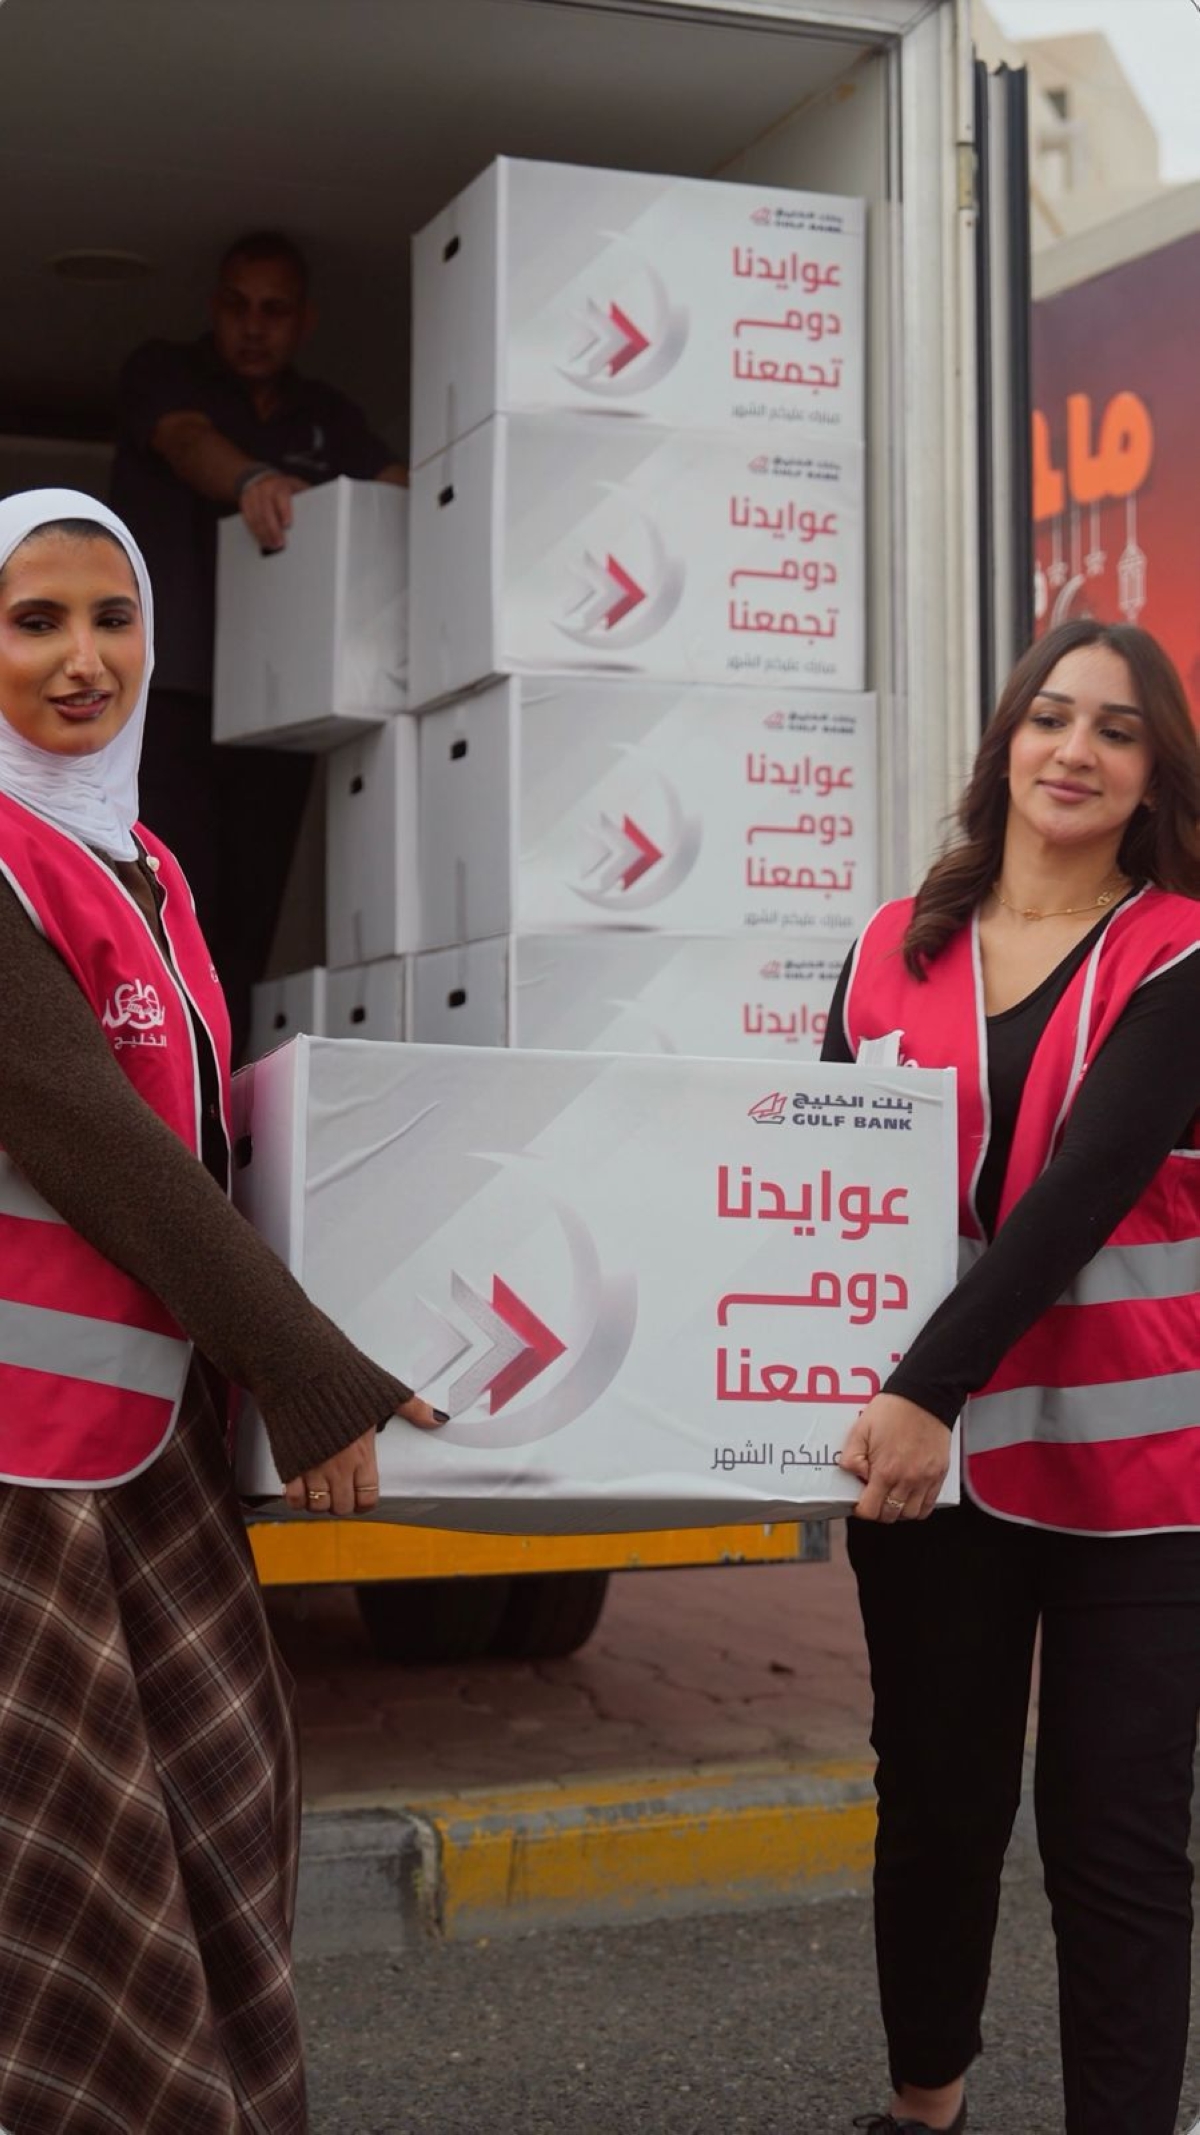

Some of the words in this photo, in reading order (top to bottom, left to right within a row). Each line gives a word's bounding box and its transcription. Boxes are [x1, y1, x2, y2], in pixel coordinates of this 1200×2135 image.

[733, 247, 841, 293] عوايدنا
[733, 349, 843, 395] تجمعنا
[730, 496, 838, 542] عوايدنا
[729, 600, 840, 645] تجمعنا
[746, 753, 853, 796] عوايدنا
[746, 857, 856, 899] تجمعنا
[114, 1033, 167, 1050] الخليج
[743, 1003, 828, 1044] وايدنا
[792, 1093, 863, 1109] الخليج
[792, 1113, 845, 1127] GULF
[854, 1116, 912, 1130] BANK
[872, 1097, 913, 1113] بنك
[718, 1165, 909, 1240] عوايدنا
[717, 1271, 908, 1326] دوم
[710, 1440, 773, 1471] الشهر
